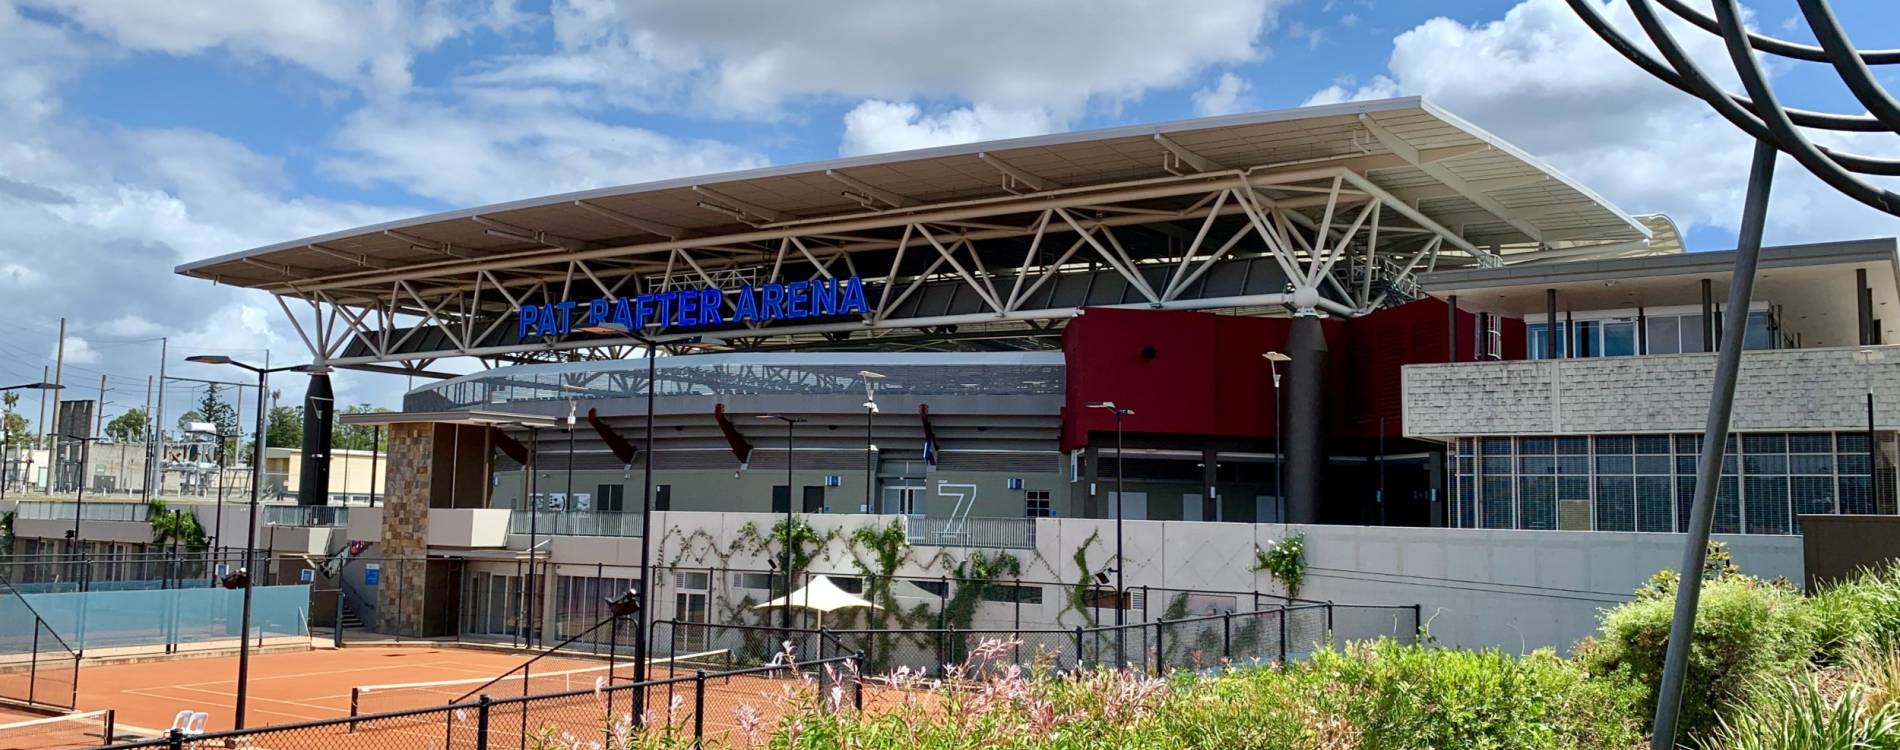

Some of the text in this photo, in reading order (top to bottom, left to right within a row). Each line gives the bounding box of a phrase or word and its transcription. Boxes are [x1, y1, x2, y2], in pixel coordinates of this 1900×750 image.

[519, 274, 868, 337] PAT RAFTER ARENA
[938, 484, 976, 537] 7
